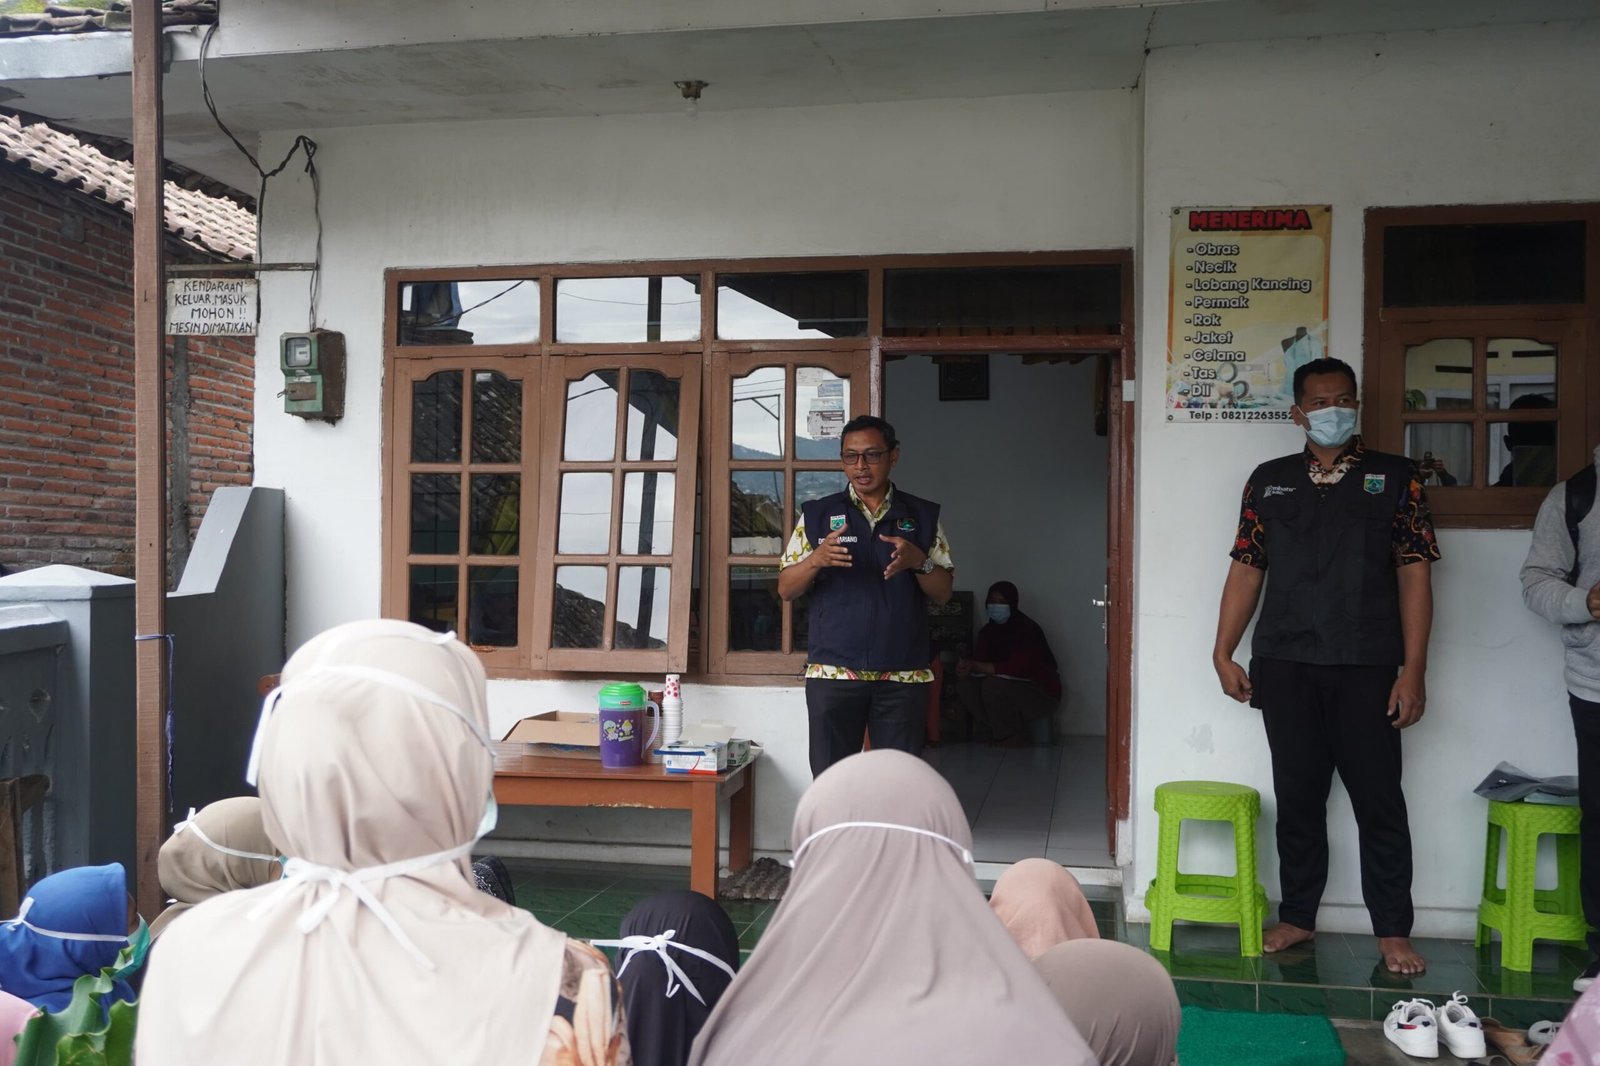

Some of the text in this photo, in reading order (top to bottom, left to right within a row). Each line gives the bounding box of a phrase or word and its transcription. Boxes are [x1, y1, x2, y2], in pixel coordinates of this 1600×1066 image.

[1189, 209, 1312, 231] MENERIMA
[1195, 243, 1240, 256] Obras
[1194, 261, 1236, 273] Necik
[183, 280, 244, 293] KENDARAAN
[1194, 279, 1248, 293] Lobang
[1251, 278, 1312, 294] Kancing
[1193, 296, 1249, 309] Permak
[191, 307, 235, 320] MOHON
[1193, 314, 1221, 326] Rok
[169, 322, 253, 335] MESIN DIMATIKAN
[1192, 331, 1233, 344] Jaket
[1192, 349, 1246, 362] Celana
[1191, 366, 1217, 379] Tas
[1189, 411, 1212, 421] Telp
[1221, 411, 1294, 420] 08212263552
